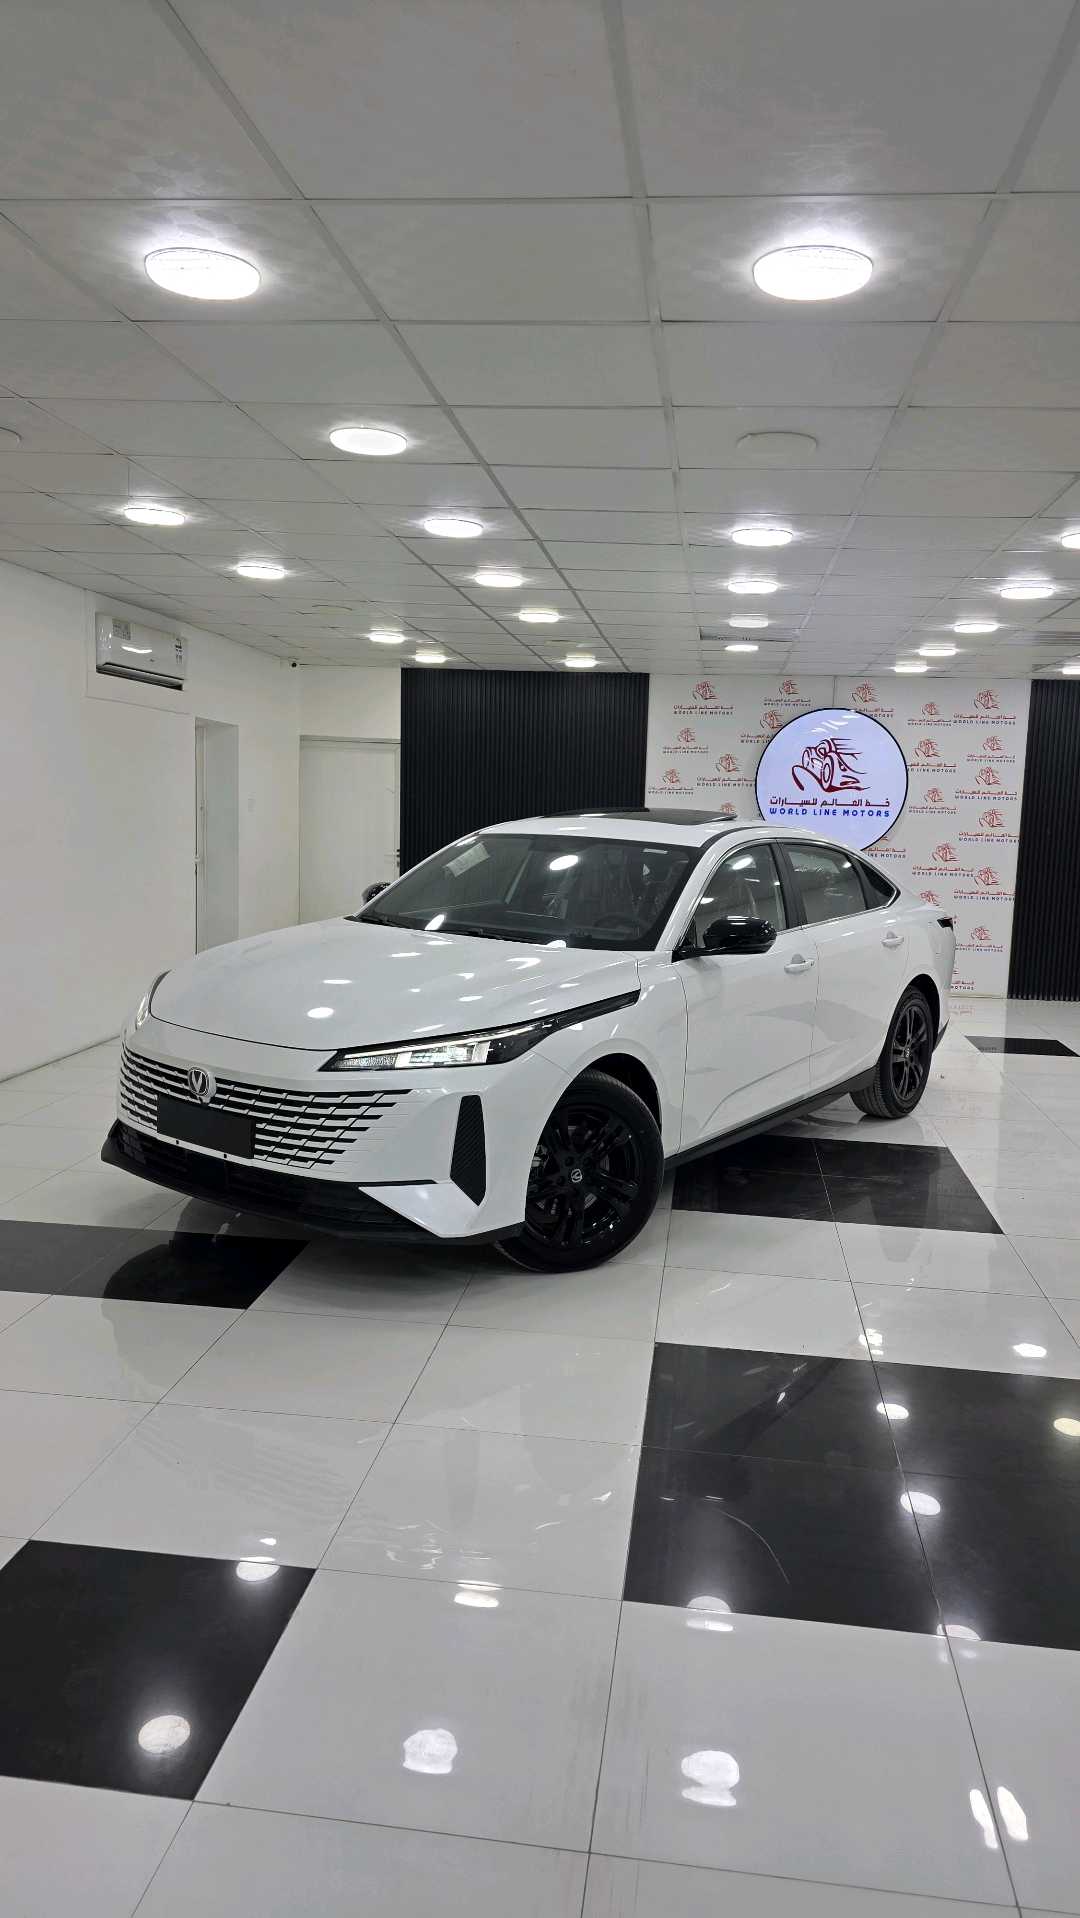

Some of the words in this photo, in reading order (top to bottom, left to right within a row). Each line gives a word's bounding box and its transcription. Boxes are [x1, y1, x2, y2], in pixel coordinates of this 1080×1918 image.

[769, 796, 818, 807] للسيارات
[820, 798, 863, 808] العالم
[865, 798, 890, 807] خط
[769, 807, 809, 816] WORLD
[813, 808, 837, 817] LINE
[842, 809, 890, 818] MOTORS
